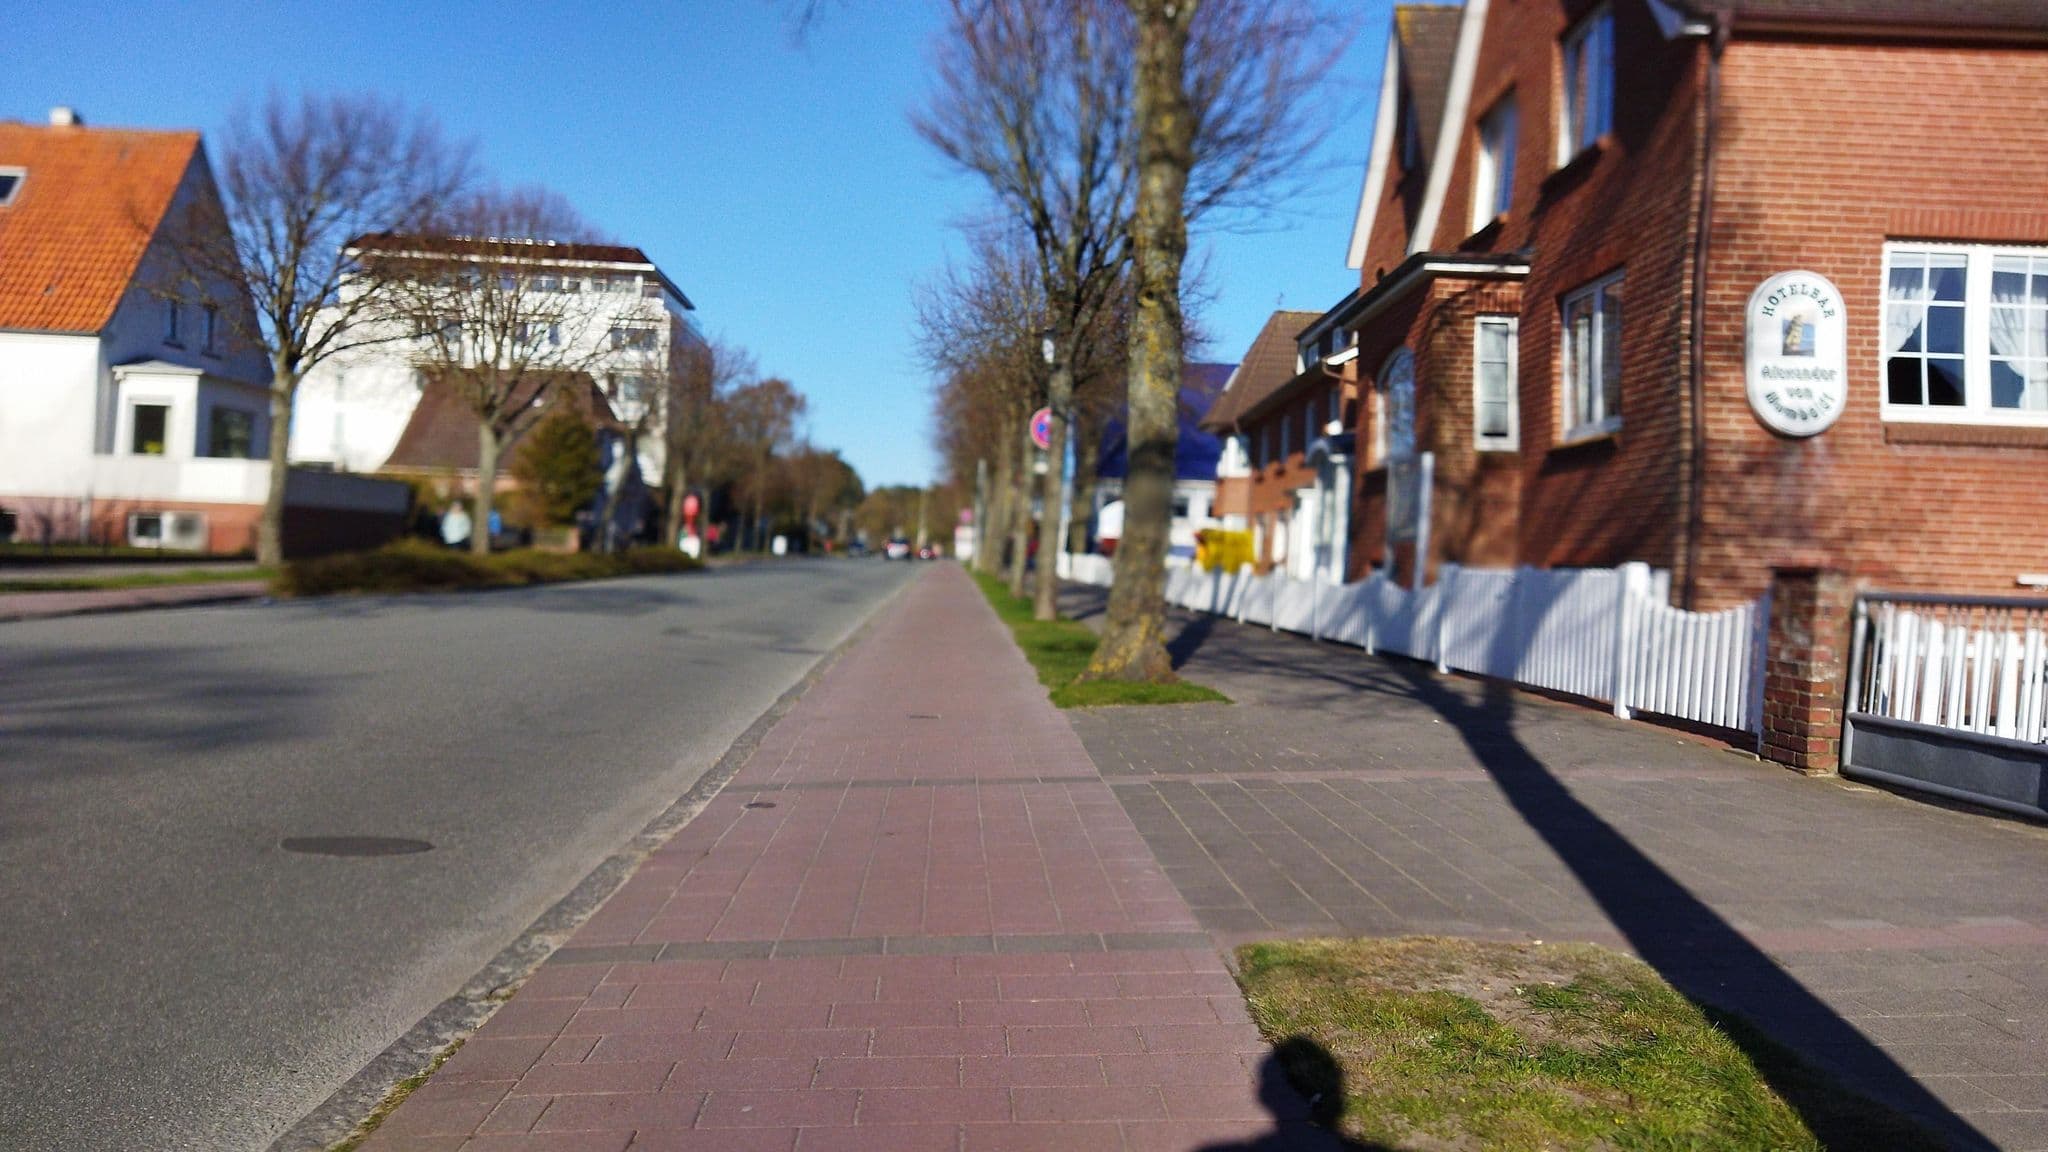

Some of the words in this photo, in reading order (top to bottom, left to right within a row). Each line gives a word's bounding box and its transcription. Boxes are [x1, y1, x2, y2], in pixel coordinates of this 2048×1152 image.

[1762, 284, 1835, 318] HOTELBAR
[1761, 366, 1836, 381] Alexander
[1786, 387, 1813, 399] von
